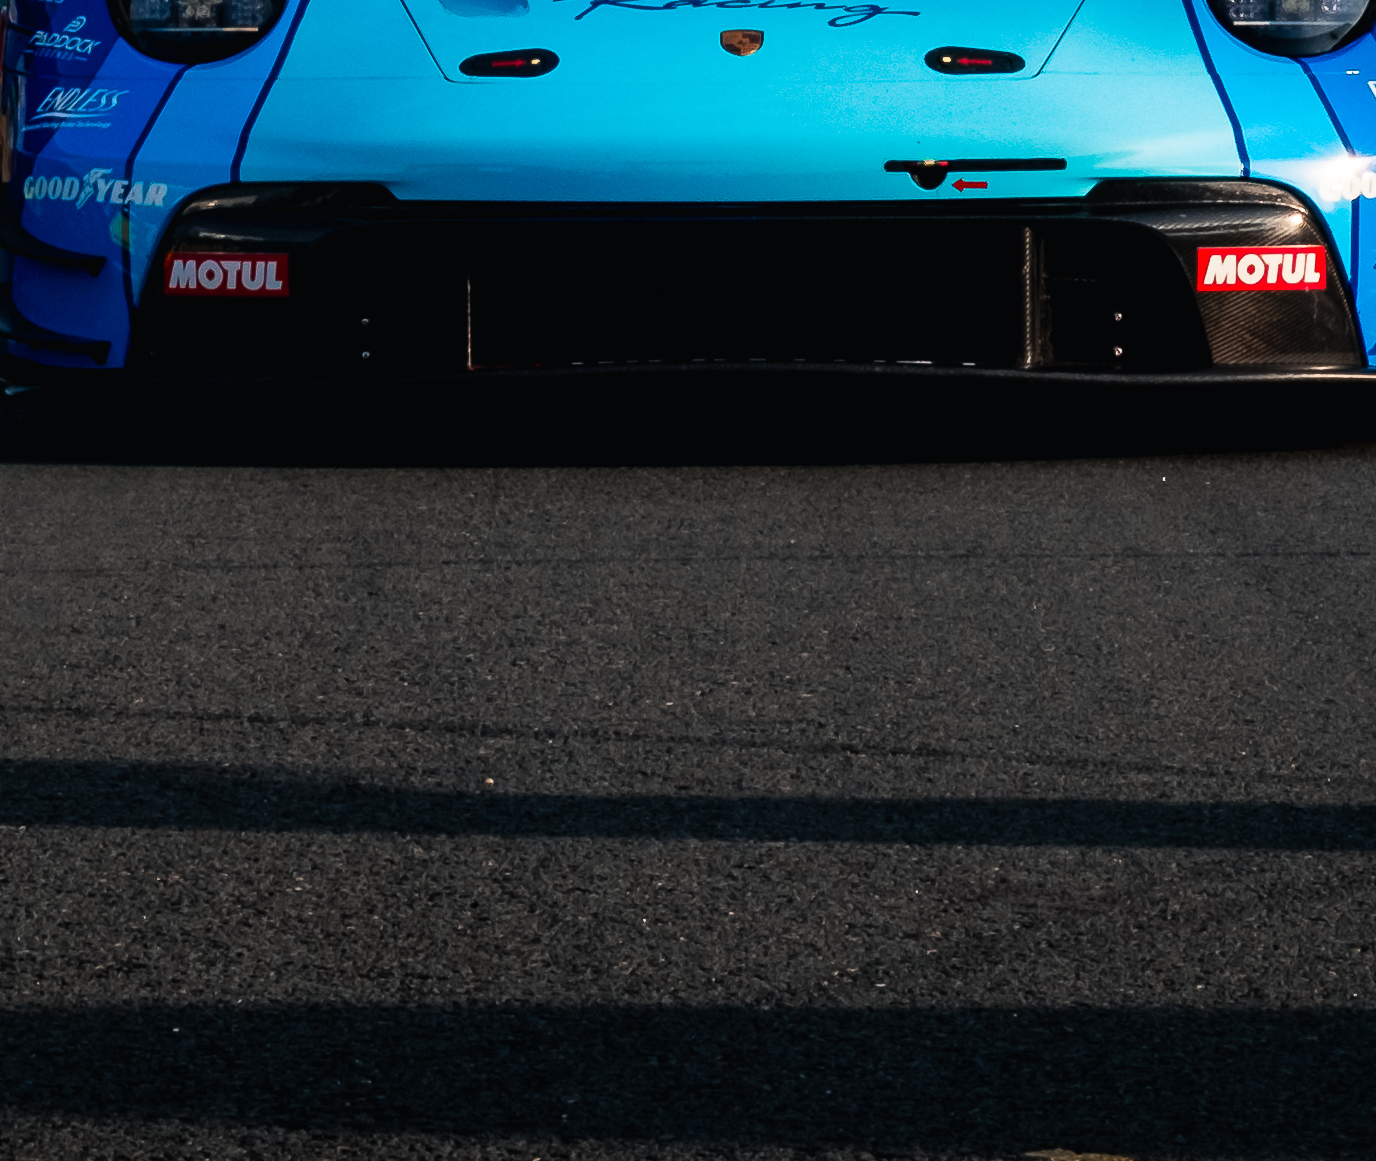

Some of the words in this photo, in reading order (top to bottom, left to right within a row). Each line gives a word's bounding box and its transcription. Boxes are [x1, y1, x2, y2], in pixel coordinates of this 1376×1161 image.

[29, 31, 101, 54] PADDOCK
[37, 87, 129, 112] ENDLESS
[24, 170, 168, 207] GOODYEAR
[169, 259, 283, 290] MOTUL
[1203, 254, 1321, 284] MOTUL
